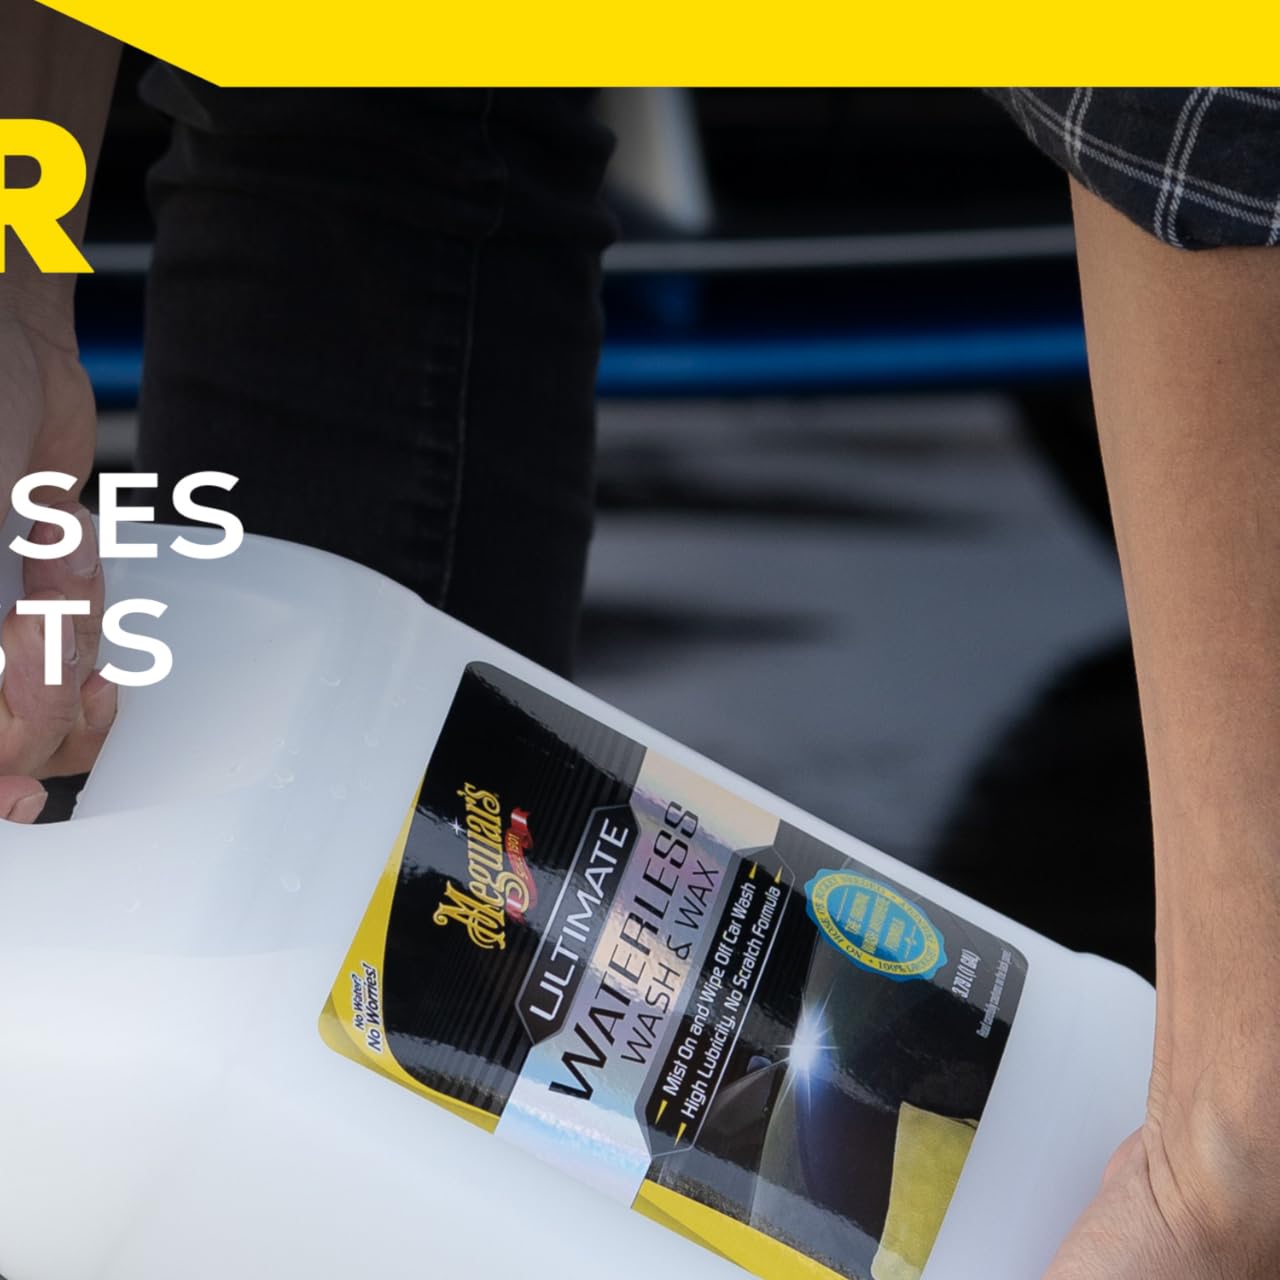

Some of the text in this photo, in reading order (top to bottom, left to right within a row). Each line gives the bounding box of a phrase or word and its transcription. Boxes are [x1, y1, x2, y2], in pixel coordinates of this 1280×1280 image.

[433, 782, 530, 951] Meguiar's
[529, 819, 631, 1022] ULTIMATE
[549, 802, 700, 1101] WATERLESS
[621, 861, 720, 1064] WASH & WAX
[353, 974, 364, 1030] No Water?
[364, 964, 381, 1052] No Worries!
[663, 882, 757, 1097] Mist On and Wipe Off Car Wash
[682, 887, 782, 1119] High Lubricity, No Scratch Formula
[951, 976, 972, 999] 3.79
